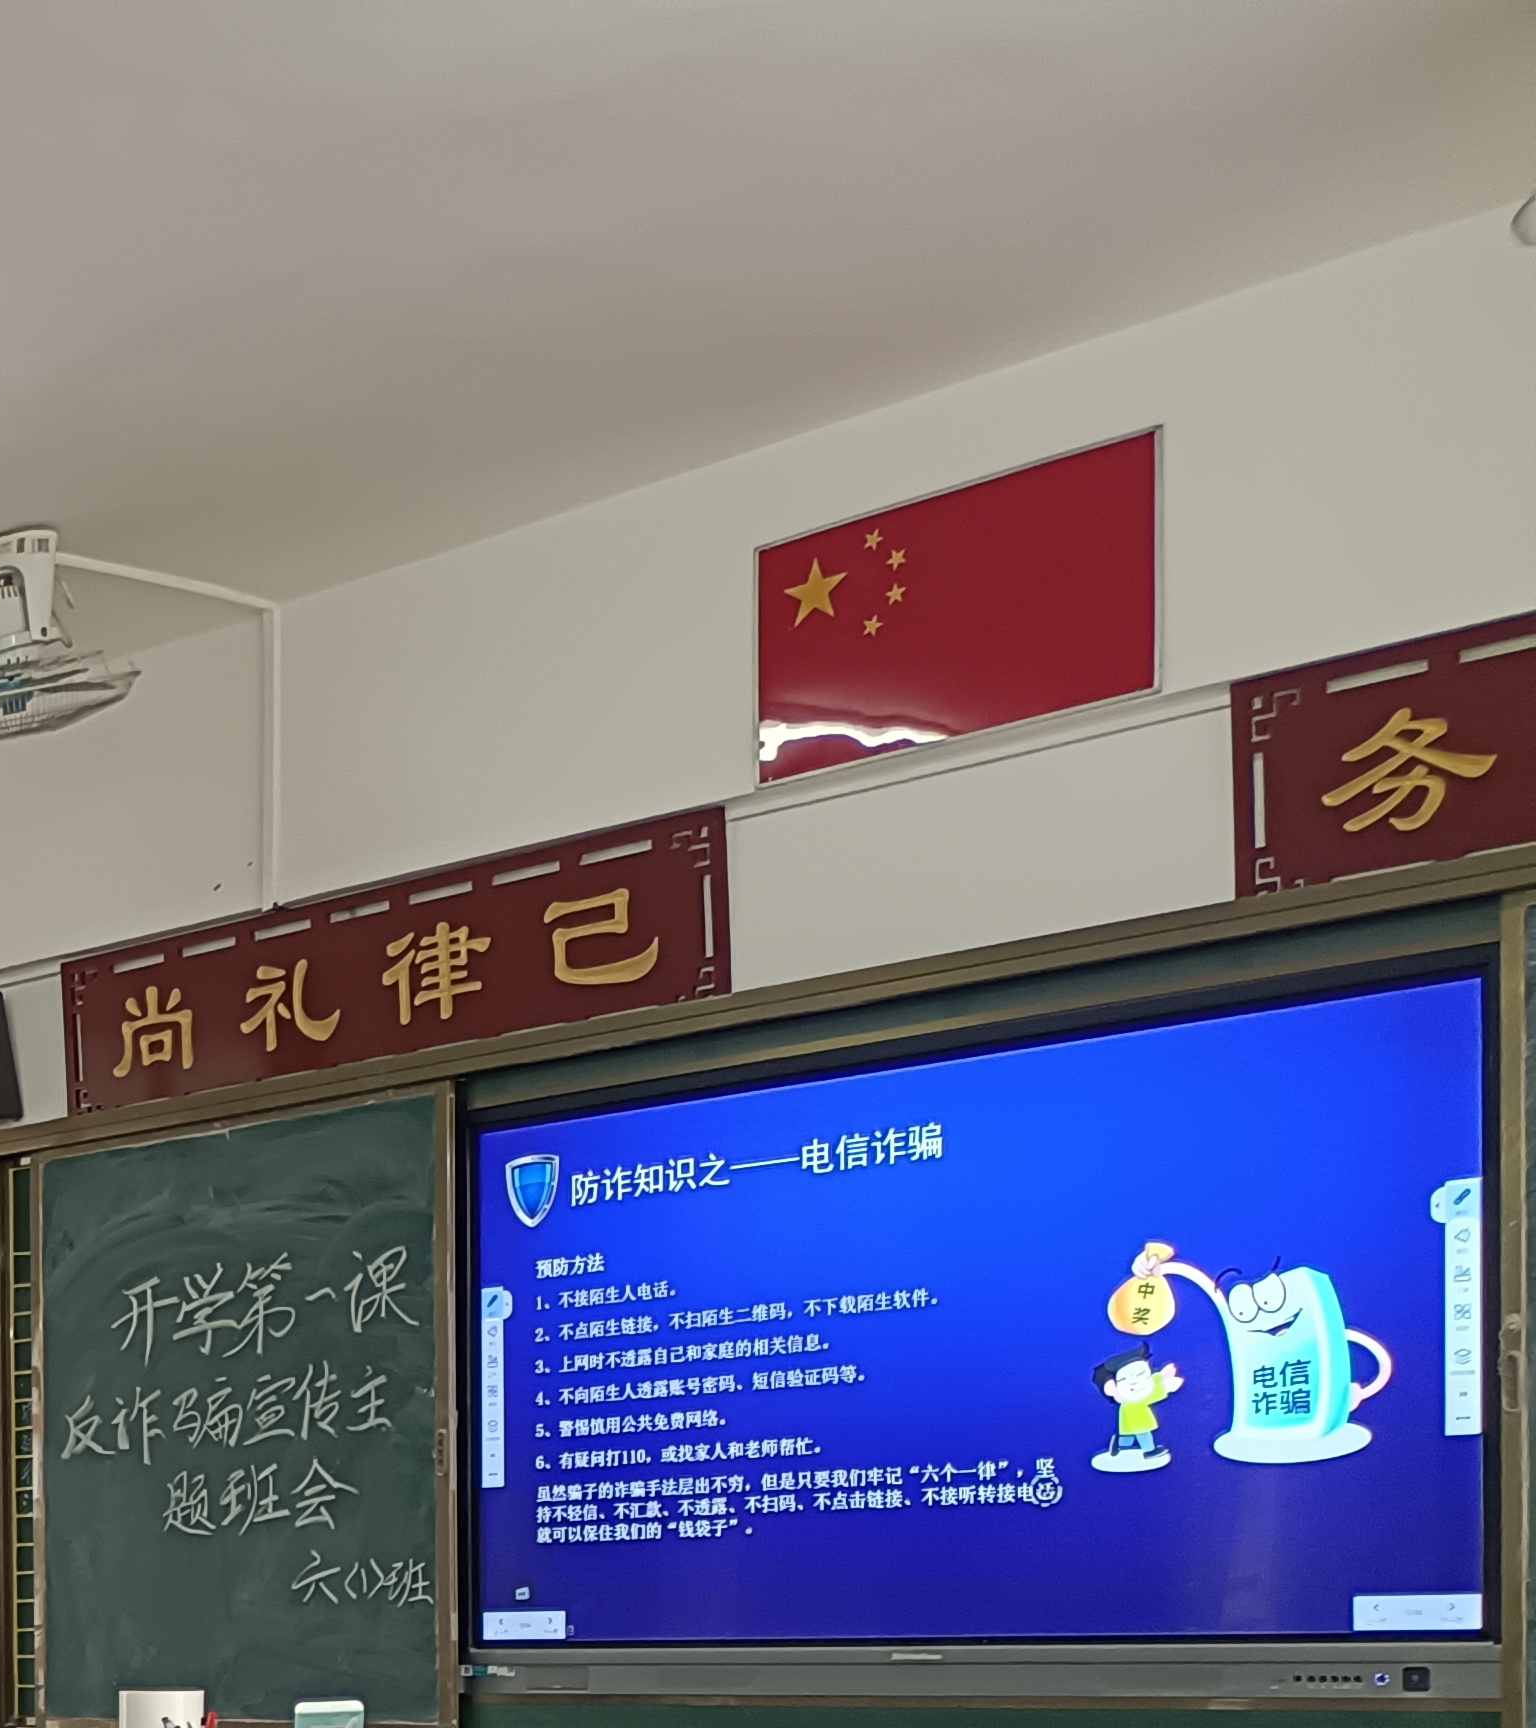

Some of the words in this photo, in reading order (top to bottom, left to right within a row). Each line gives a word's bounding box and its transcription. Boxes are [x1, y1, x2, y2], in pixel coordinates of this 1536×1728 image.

[1321, 707, 1498, 832] 务
[113, 887, 659, 1078] 尚礼律己
[111, 1246, 420, 1367] 开学第一课
[535, 1252, 605, 1279] 预防方法
[60, 1360, 392, 1465] 反诈骗宣传主
[1252, 1359, 1311, 1389] 电信
[1252, 1388, 1311, 1416] 诈骗
[164, 1459, 360, 1536] 题班会
